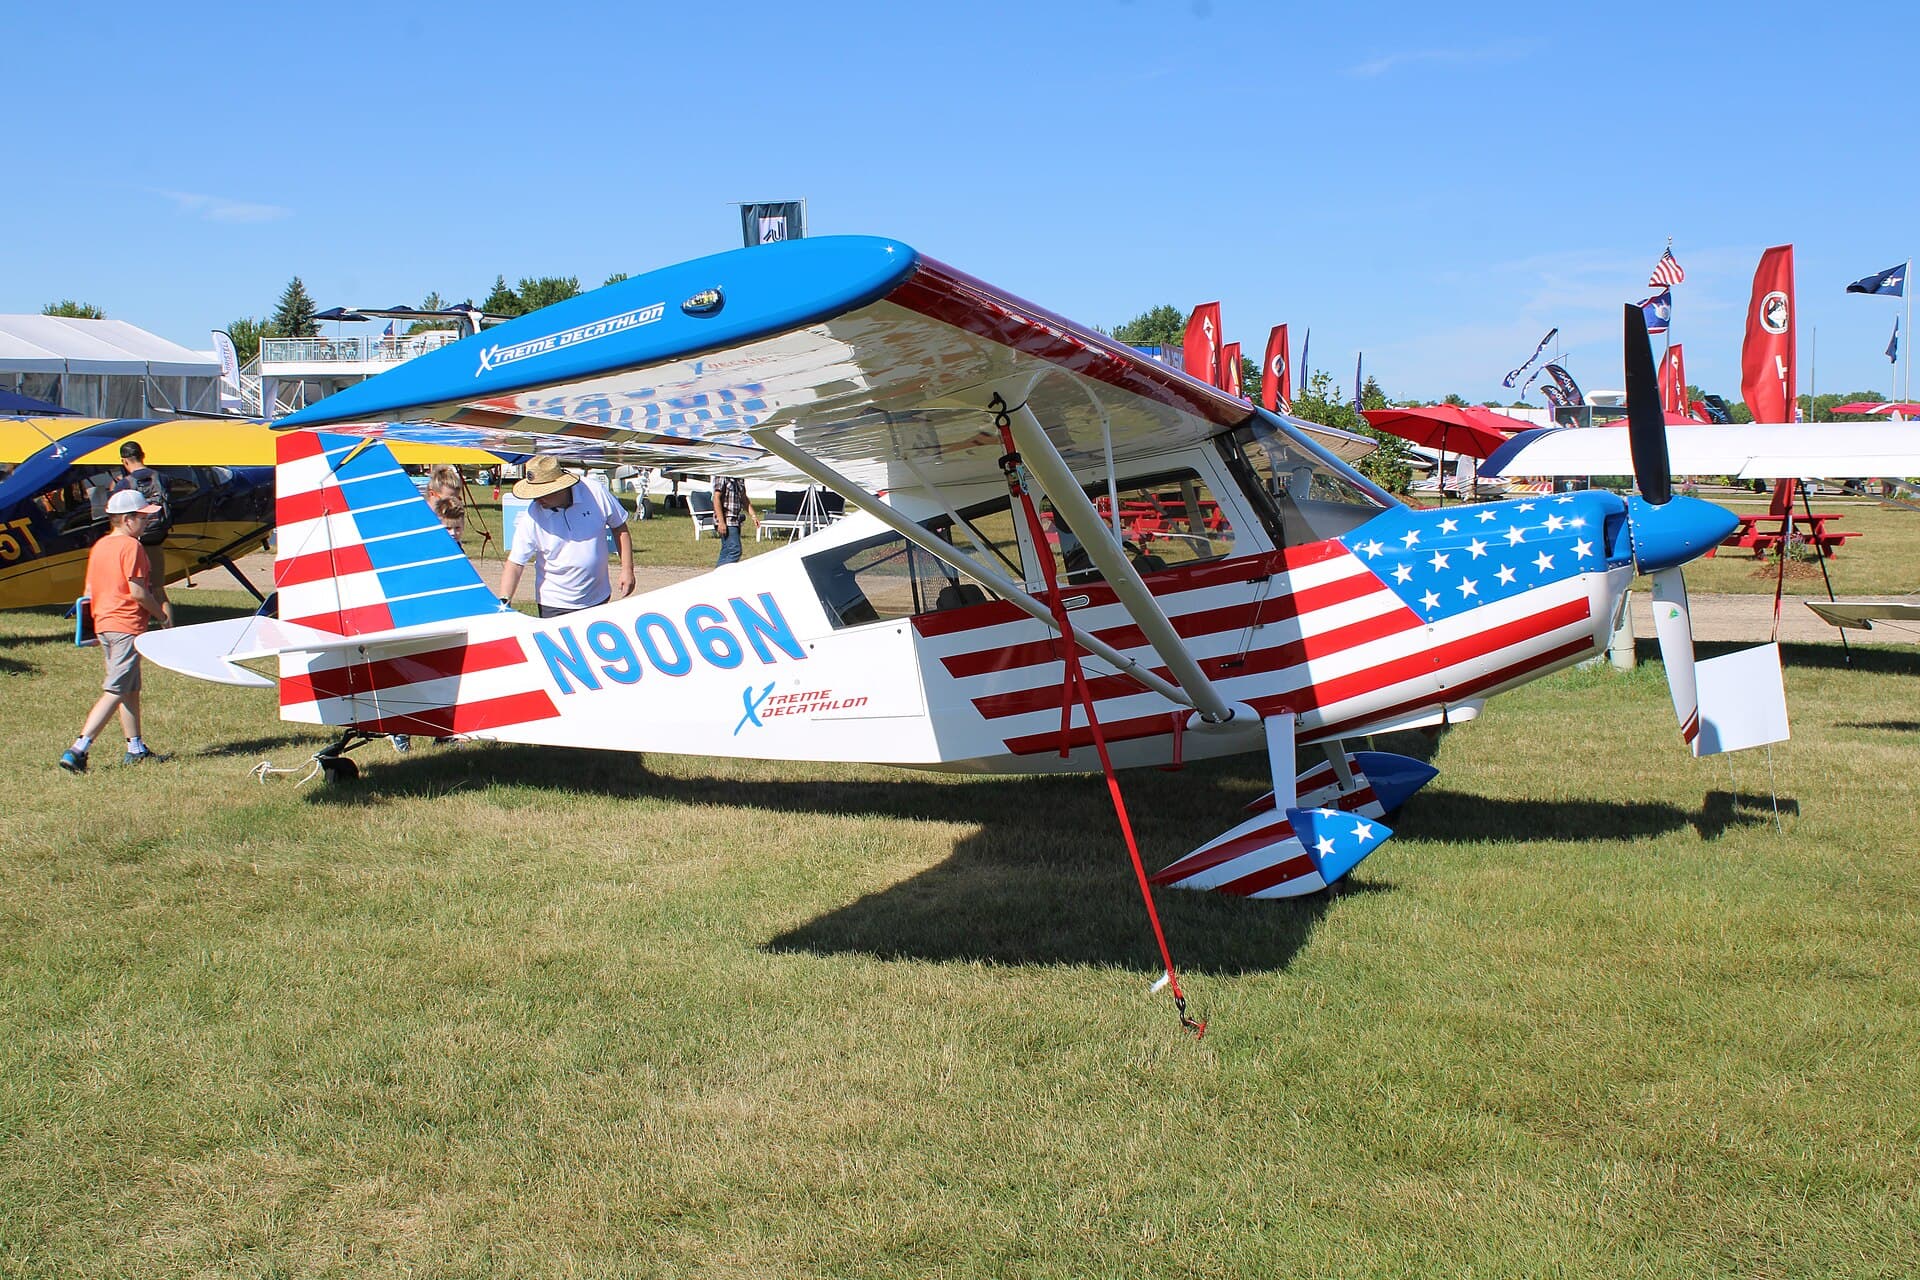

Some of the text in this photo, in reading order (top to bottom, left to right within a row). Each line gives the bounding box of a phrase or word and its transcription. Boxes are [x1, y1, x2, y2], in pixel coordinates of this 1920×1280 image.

[559, 306, 665, 346] DECATHLON
[533, 592, 808, 695] N906N
[762, 697, 868, 718] DECATHLON
